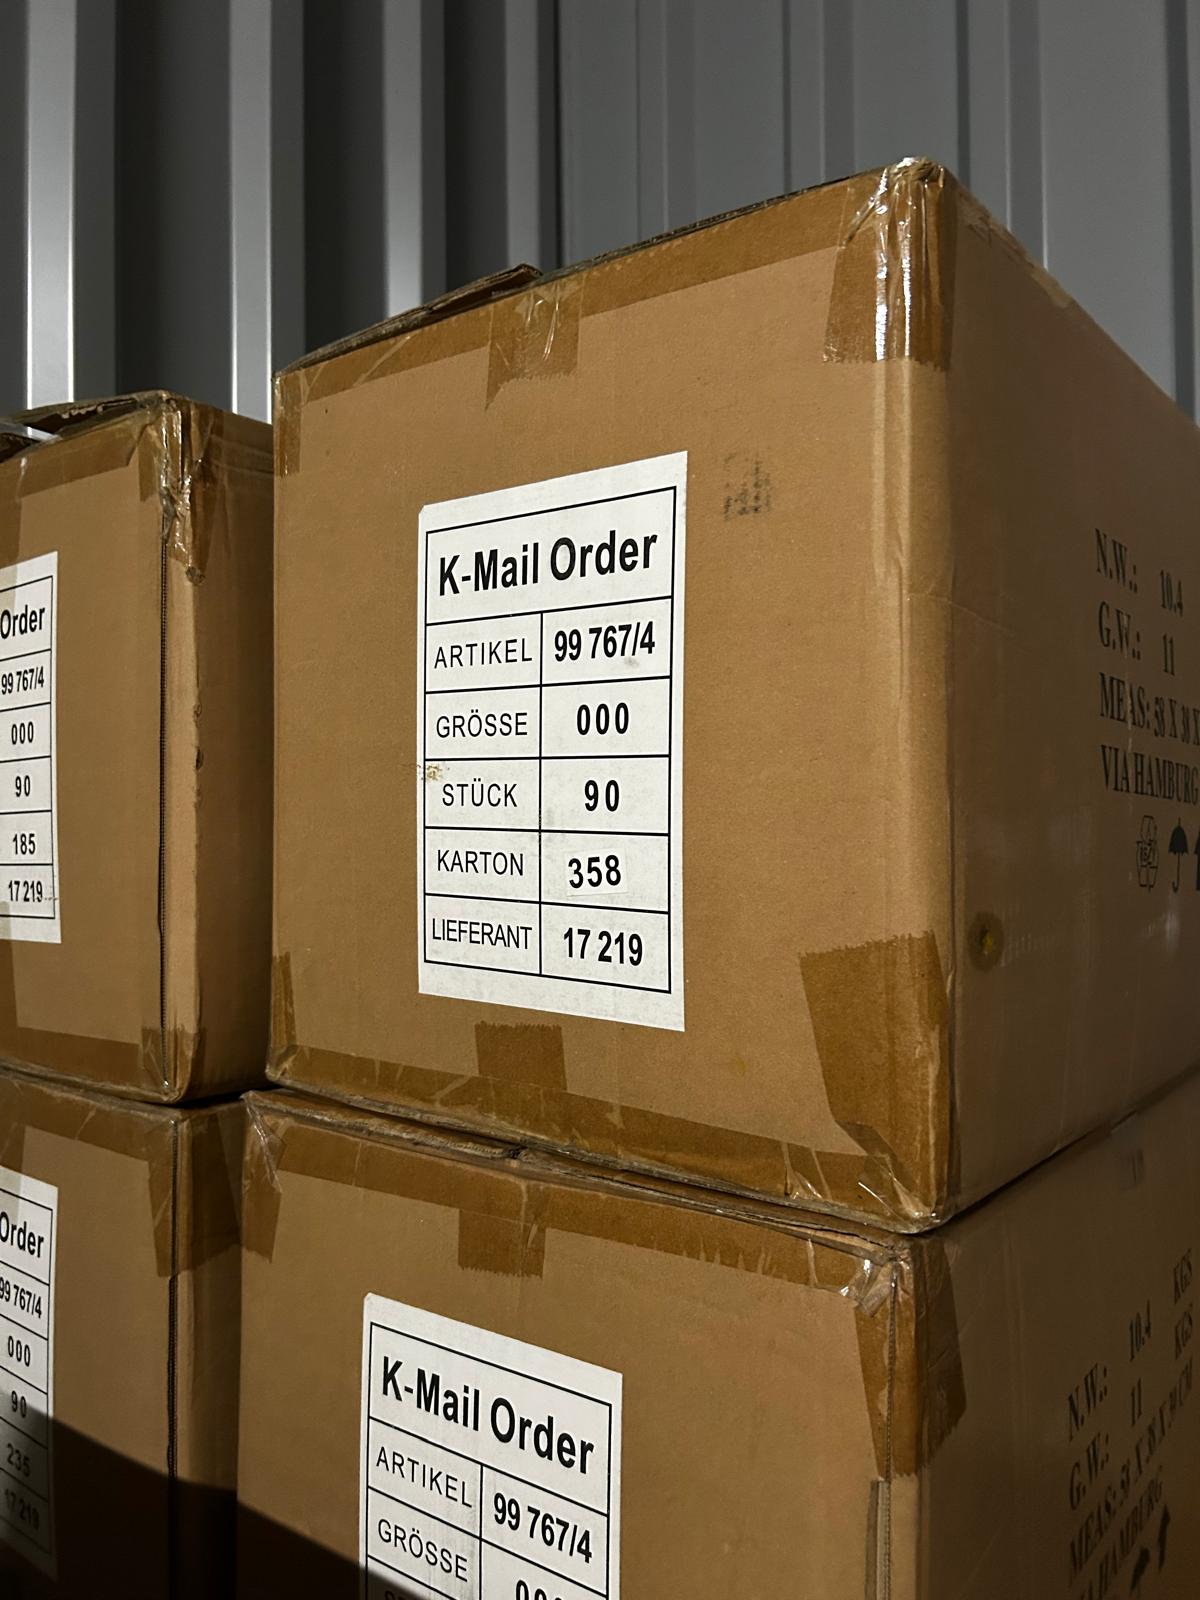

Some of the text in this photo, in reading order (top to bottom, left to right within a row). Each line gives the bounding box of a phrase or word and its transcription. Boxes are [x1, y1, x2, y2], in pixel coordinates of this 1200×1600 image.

[439, 529, 658, 597] K-Mail Order
[1095, 528, 1138, 593] N.W.:
[0, 604, 45, 639] Order
[434, 621, 655, 669] ARTIKEL 99 767/4
[1162, 633, 1175, 677] 11
[1, 666, 44, 695] 99 767/4
[11, 721, 34, 746] 000
[436, 702, 629, 738] GRÖSSE 000
[15, 775, 31, 798] 90
[1101, 744, 1200, 806] VIA HAMBURG
[442, 778, 620, 812] STÜCK 90
[13, 833, 36, 855] 185
[437, 849, 622, 888] KARTON 358
[8, 880, 43, 903] 17 219
[432, 918, 643, 967] LIEFERANT 17 219
[0, 1211, 44, 1259] Order
[13, 1284, 42, 1319] 767/4
[7, 1335, 31, 1368] 000
[11, 1390, 27, 1419] 90
[382, 1356, 595, 1474] K-Mail Order
[7, 1443, 30, 1478] 235
[376, 1446, 593, 1564] ARTIKEL 99 767/4
[378, 1518, 469, 1582] GRÖSSE
